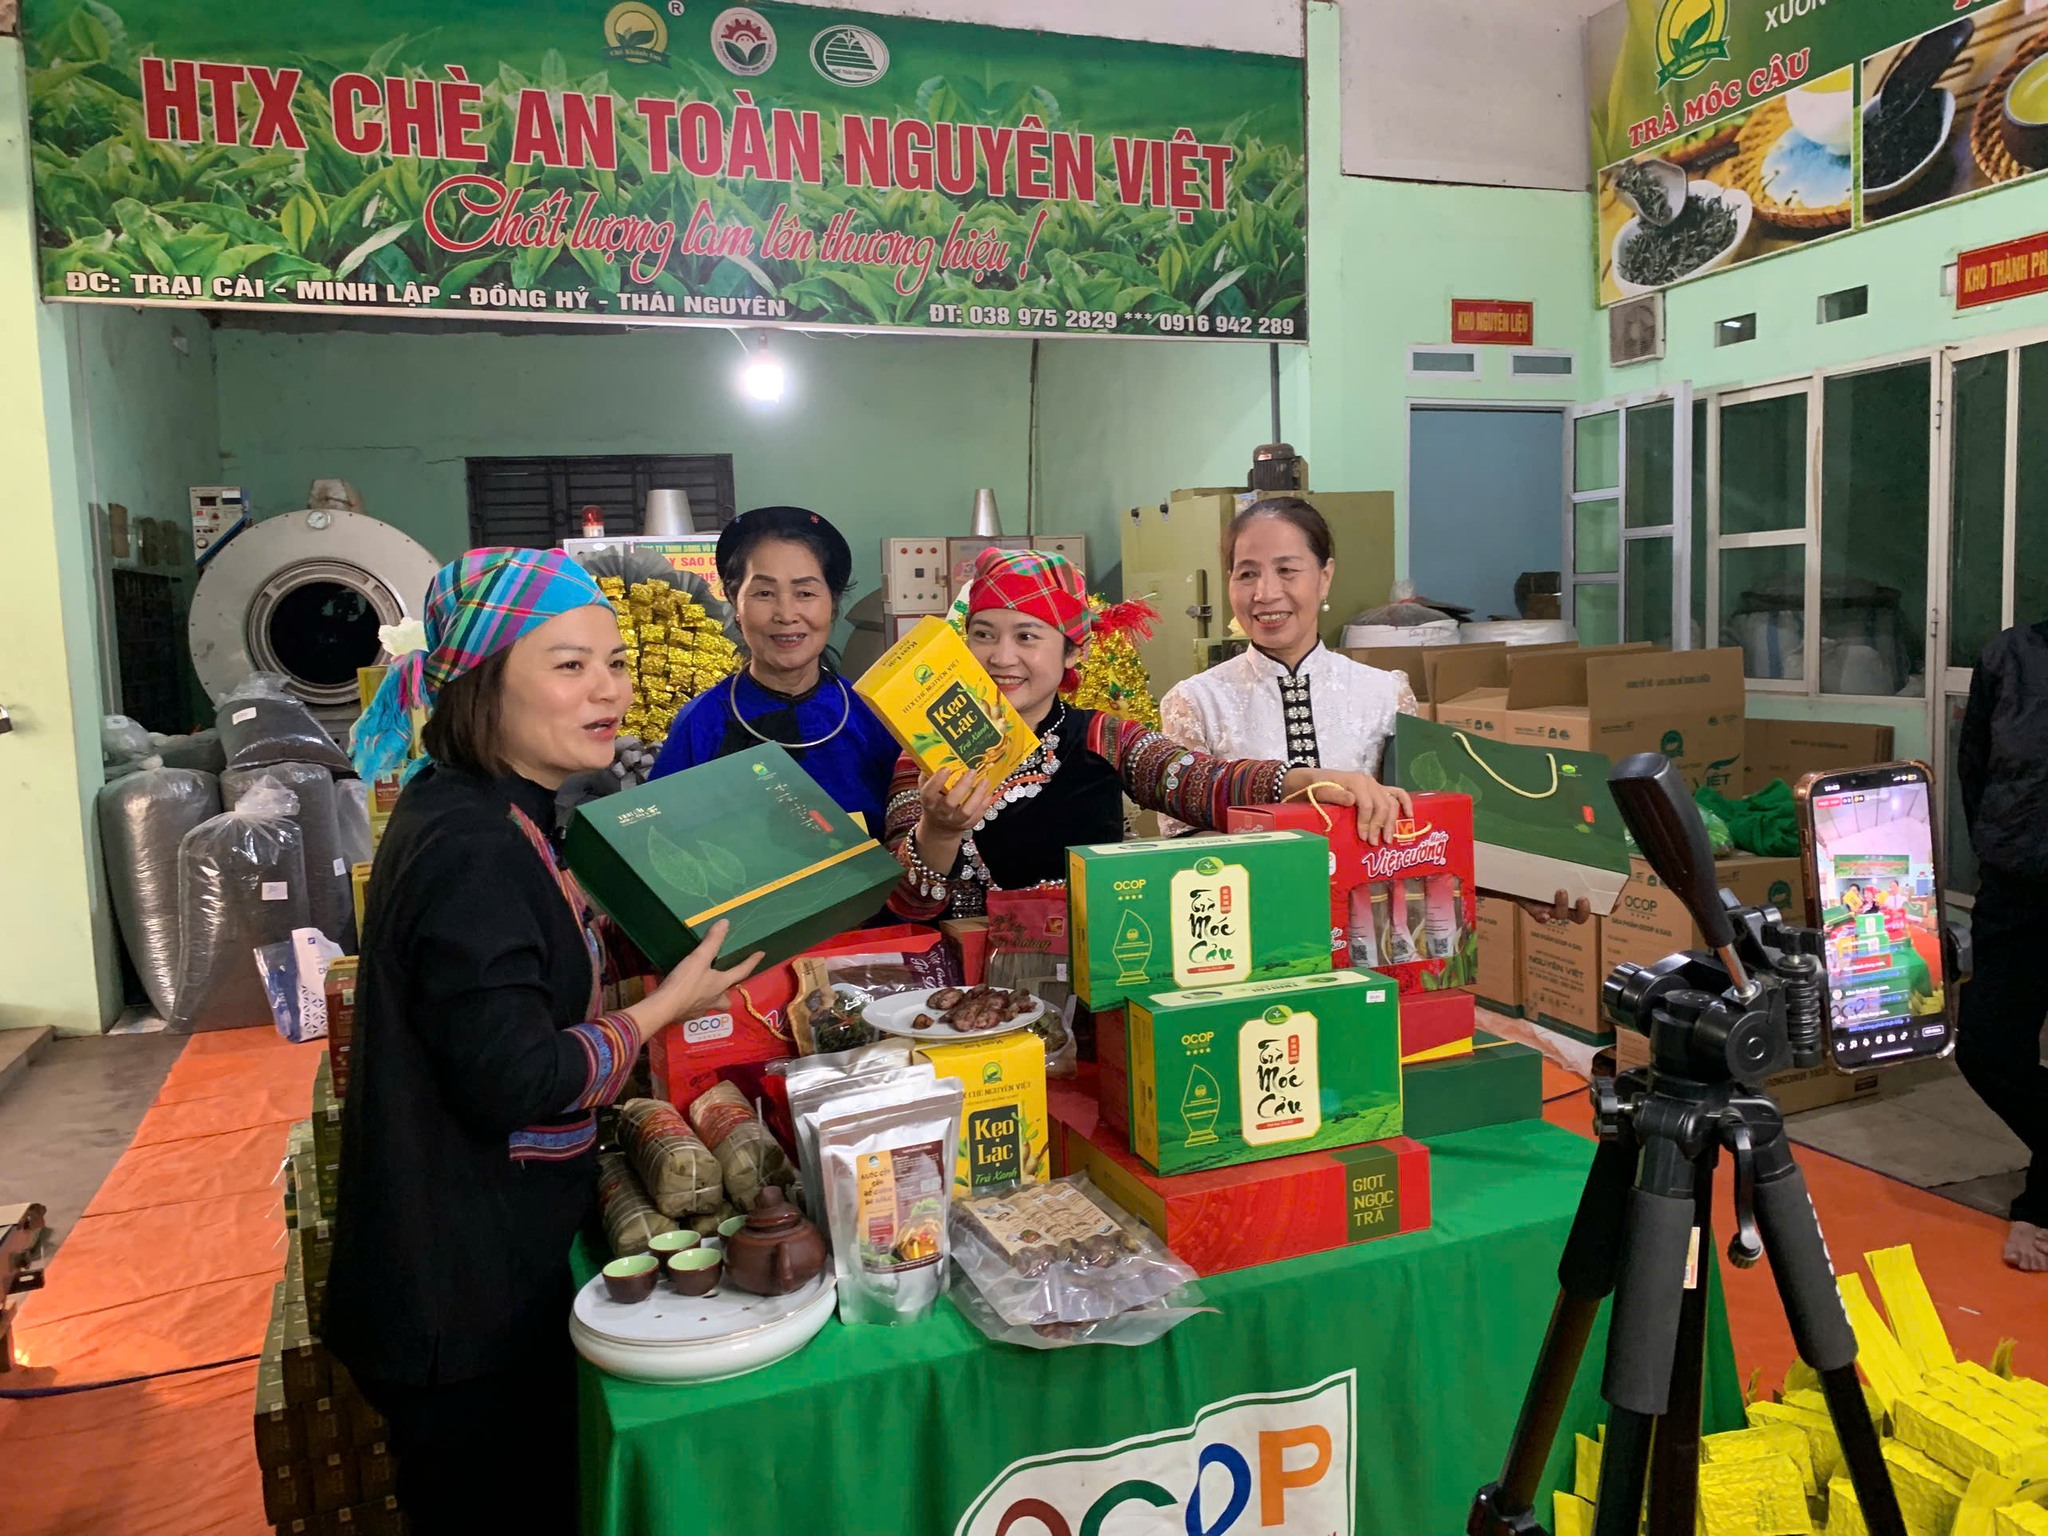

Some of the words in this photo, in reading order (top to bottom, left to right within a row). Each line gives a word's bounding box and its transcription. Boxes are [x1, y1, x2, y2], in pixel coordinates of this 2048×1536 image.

[1628, 103, 1680, 149] TRÀ
[1684, 78, 1741, 127] MÓC
[1747, 47, 1811, 95] CÂU
[139, 56, 310, 151] HTX
[330, 64, 489, 163] CHÈ
[512, 88, 618, 171] AN
[635, 89, 823, 184] TOÀN
[842, 115, 1097, 202] NGUYÊN
[1111, 128, 1234, 225] VIỆT
[423, 173, 567, 253] Chất
[570, 190, 677, 285] lượng
[680, 200, 754, 257] làm
[761, 203, 814, 260] lên
[821, 207, 934, 296] thương
[941, 212, 1012, 284] hiệu
[1964, 264, 1987, 293] KHO
[1990, 252, 2028, 287] THÀNH
[65, 271, 121, 293] ĐC:
[129, 273, 203, 300] TRẠI
[212, 274, 264, 298] CÀI
[297, 281, 376, 302] MINH
[387, 280, 440, 307] LẬP
[469, 281, 547, 309] ĐỒNG
[554, 285, 589, 310] HỶ
[617, 290, 675, 313] THÁI
[683, 291, 788, 317] NGUYÊN
[929, 303, 963, 325] ĐT:
[969, 307, 1011, 327] 038
[1018, 308, 1058, 328] 975
[1065, 310, 1118, 330] 2829
[1158, 313, 1210, 334] 0916
[1215, 315, 1254, 335] 942
[1257, 316, 1295, 336] 289
[1458, 311, 1475, 331] KHO
[681, 557, 705, 567] SAO
[932, 694, 967, 727] Kẹo
[946, 710, 978, 740] Lạc
[1113, 878, 1147, 891] OCOP
[1624, 895, 1657, 912] OCOP
[688, 1015, 730, 1033] OCOP
[1181, 1031, 1215, 1046] OCOP
[974, 1118, 1015, 1142] Kẹo
[977, 1143, 1013, 1167] Lạc
[993, 1166, 1018, 1182] Xanh
[1352, 1173, 1386, 1192] GIỌT
[1354, 1190, 1394, 1210] NGỌC
